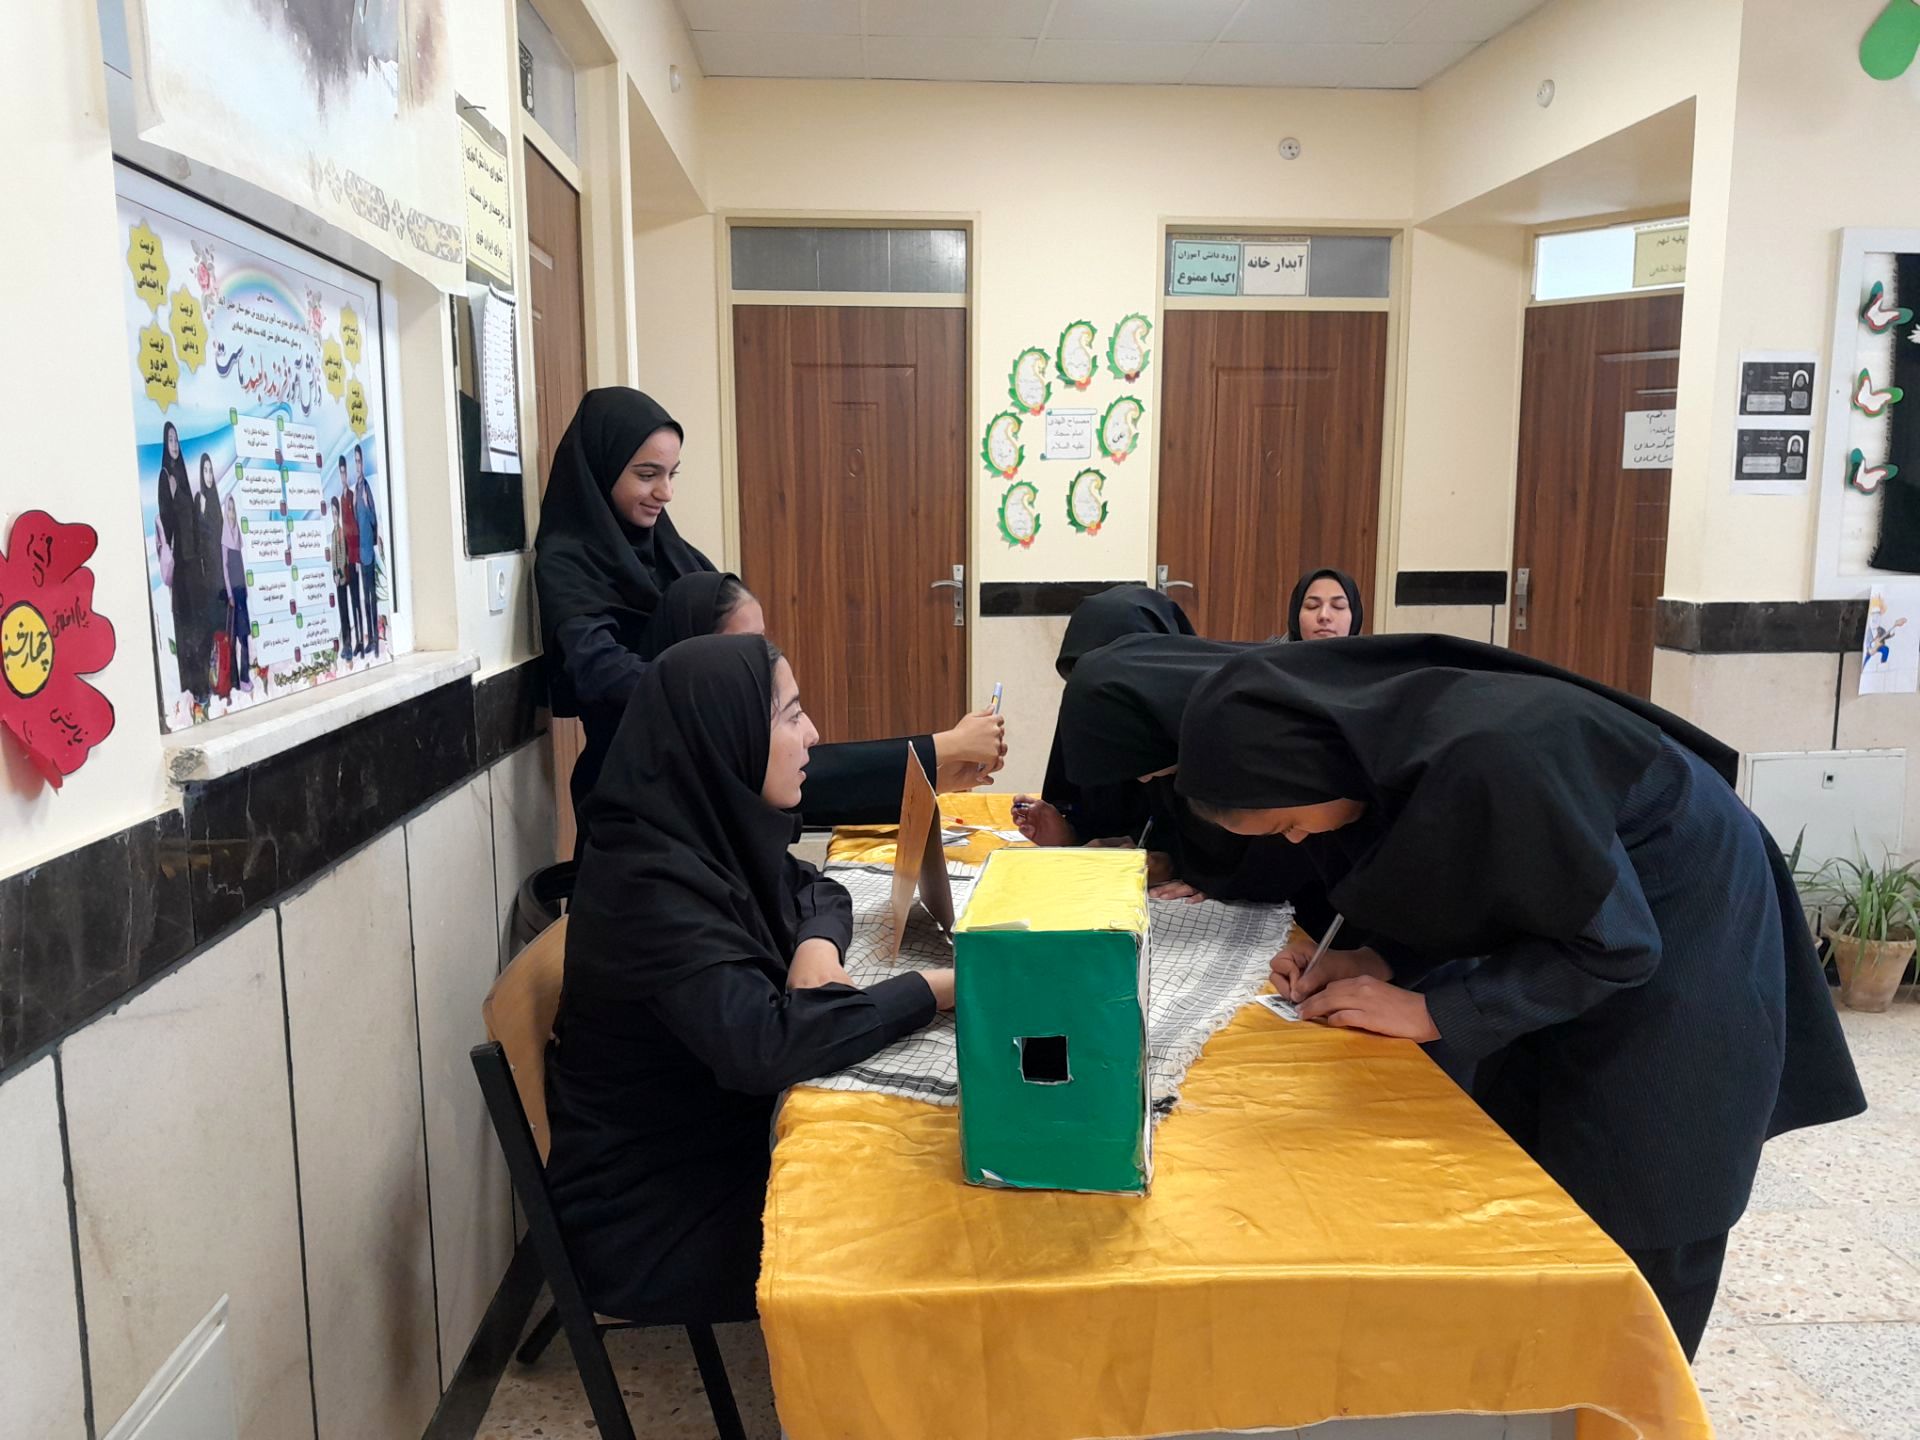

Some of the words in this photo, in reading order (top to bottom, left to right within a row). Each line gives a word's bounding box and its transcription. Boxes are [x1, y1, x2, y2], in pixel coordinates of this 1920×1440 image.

[139, 239, 155, 256] تربیت
[1178, 249, 1201, 260] آموزان
[1202, 250, 1220, 261] دانش
[1221, 252, 1237, 262] ورود
[1247, 256, 1271, 269] خانه
[1274, 254, 1305, 272] آبدار
[1177, 271, 1208, 285] ممنوع
[1210, 272, 1235, 286] اکیدا
[180, 302, 194, 318] تربیت
[149, 337, 165, 354] تربیت
